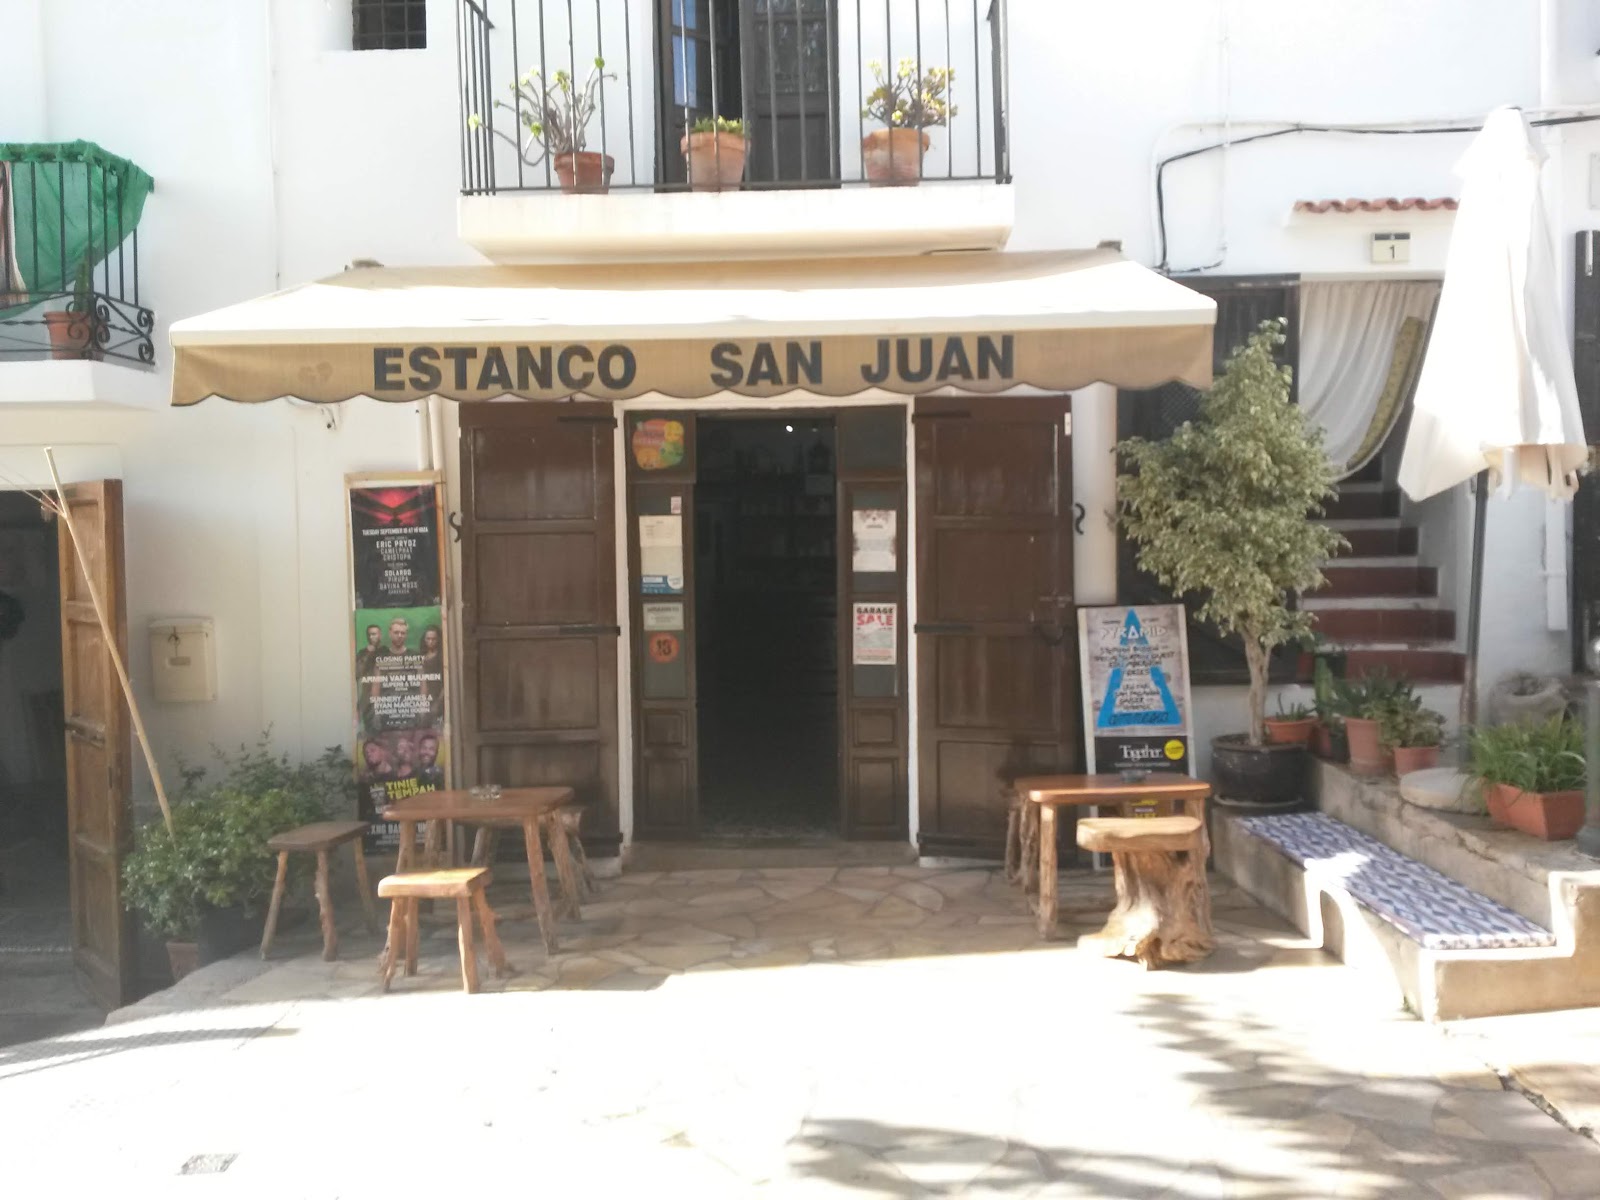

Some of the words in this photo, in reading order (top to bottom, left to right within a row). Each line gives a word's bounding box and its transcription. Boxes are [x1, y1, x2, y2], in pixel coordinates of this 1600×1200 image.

[1389, 244, 1395, 259] 1
[373, 344, 637, 391] ESTANCO
[710, 341, 822, 387] SAN
[860, 335, 1013, 383] JUAN
[376, 540, 392, 548] ERIC
[394, 539, 416, 547] PRYDZ
[384, 569, 412, 577] SOLARDO
[856, 614, 893, 626] SALE
[1102, 626, 1166, 640] PYRAMID
[375, 655, 403, 663] CLOSING
[362, 675, 388, 683] ARMIN
[390, 674, 406, 682] VAN
[407, 673, 441, 681] BUUREN
[385, 778, 417, 791] TINIE
[387, 784, 435, 800] TEMPAH
